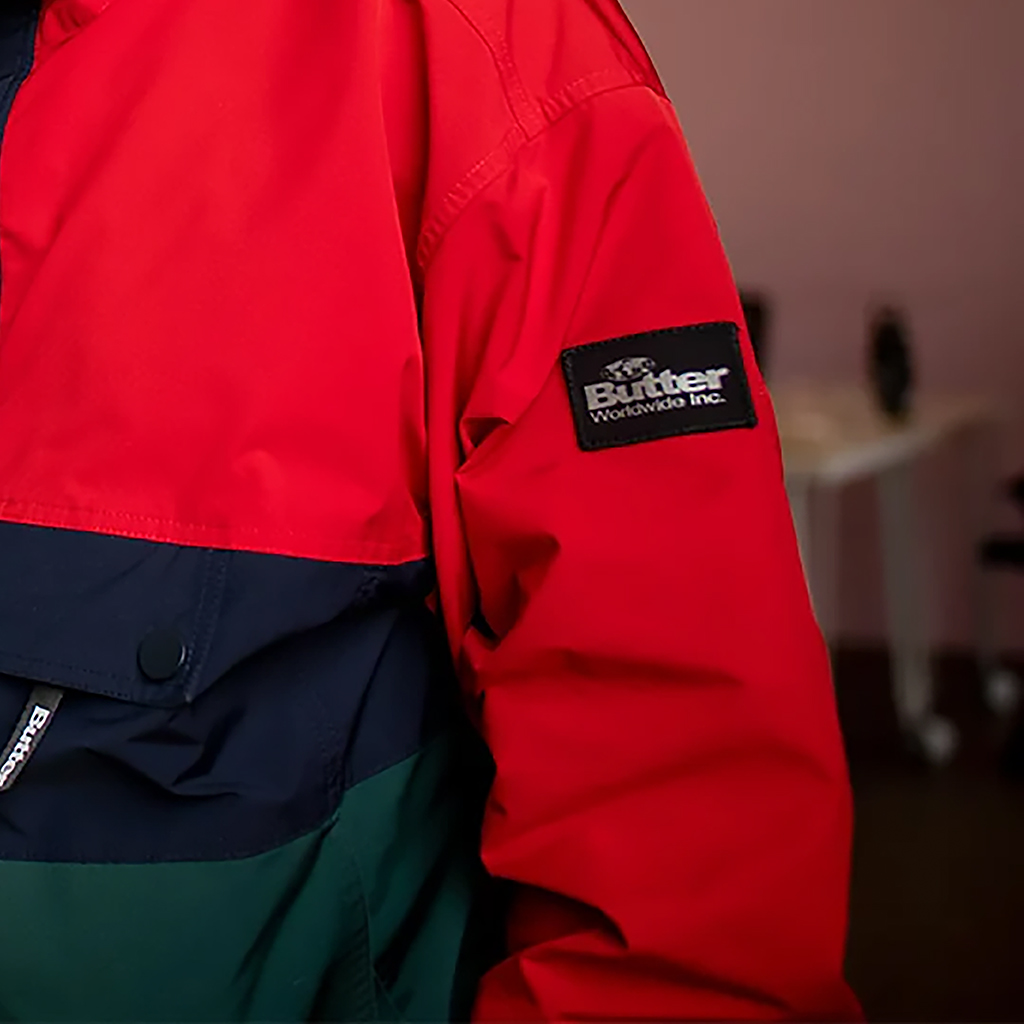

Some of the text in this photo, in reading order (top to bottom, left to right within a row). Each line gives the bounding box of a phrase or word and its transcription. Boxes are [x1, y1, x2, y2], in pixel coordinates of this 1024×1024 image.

[584, 367, 730, 410] Butter
[590, 392, 727, 423] Worldwide Inc.
